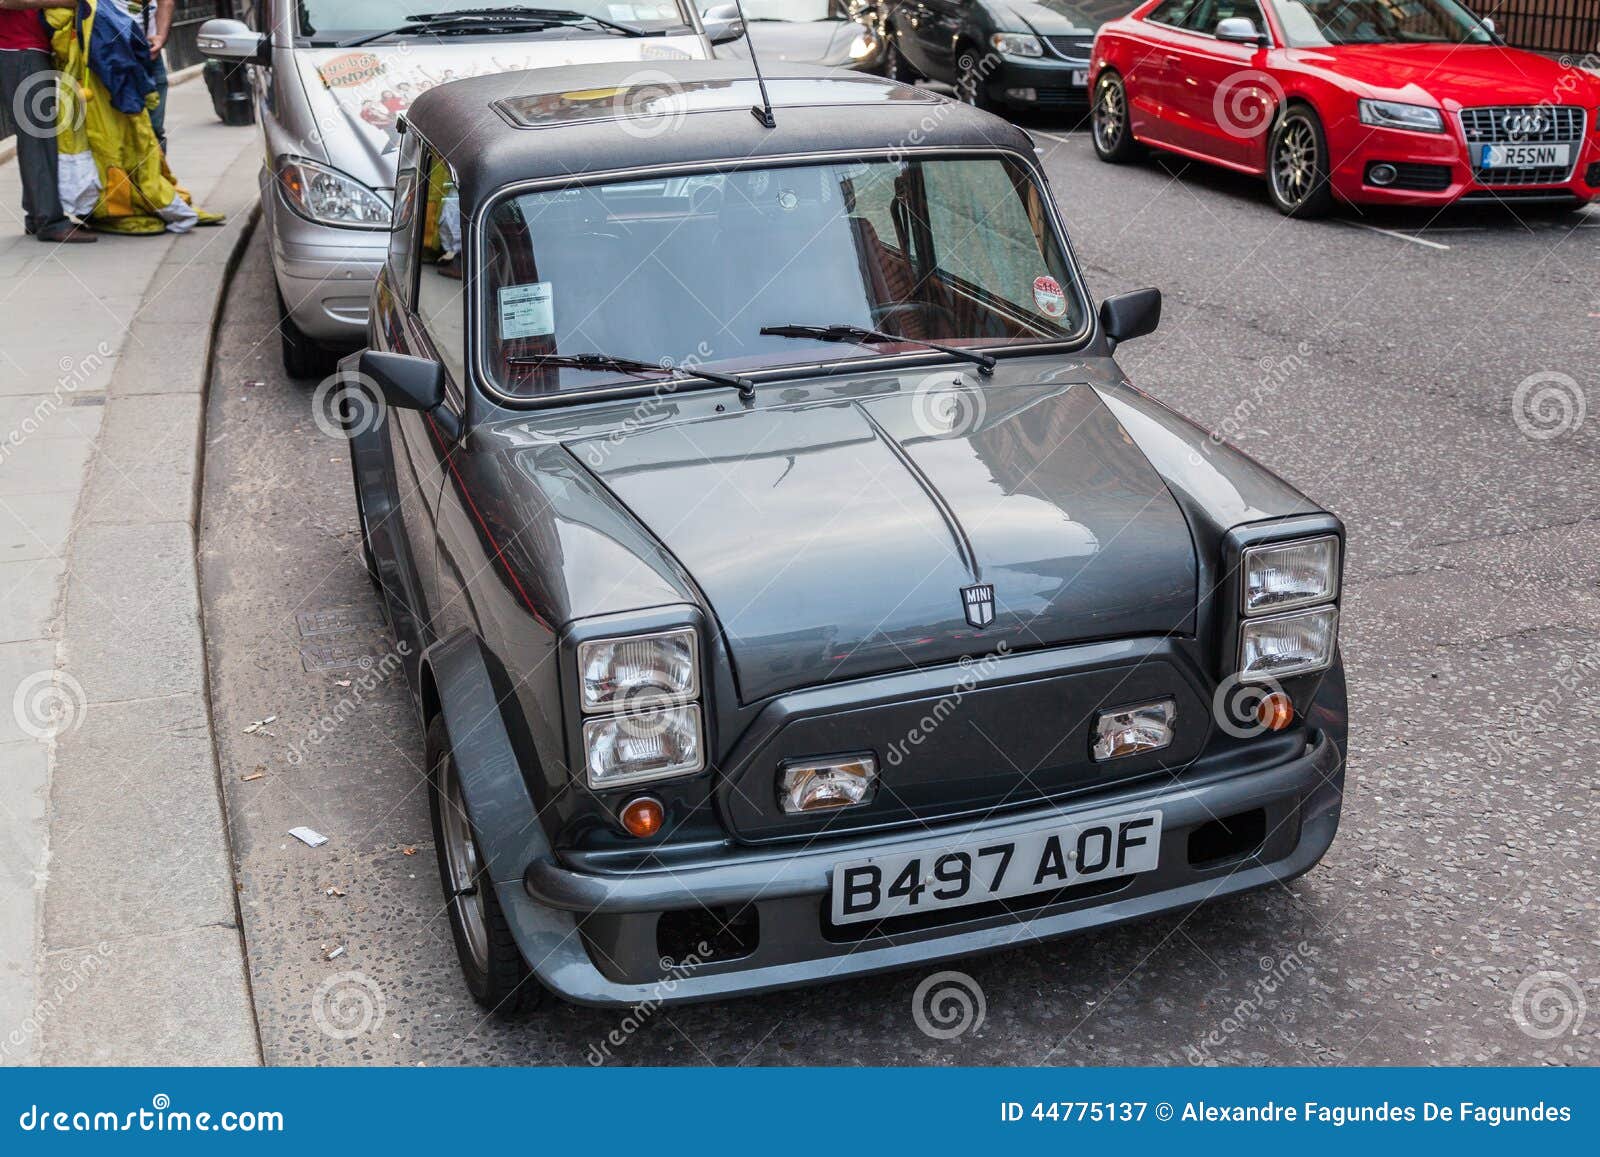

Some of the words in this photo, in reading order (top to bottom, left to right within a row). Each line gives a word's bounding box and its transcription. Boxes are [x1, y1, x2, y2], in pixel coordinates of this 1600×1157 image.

[1505, 147, 1557, 165] R5SNN
[966, 587, 991, 603] MINI
[843, 842, 1016, 916] B497
[1032, 816, 1155, 886] AOF
